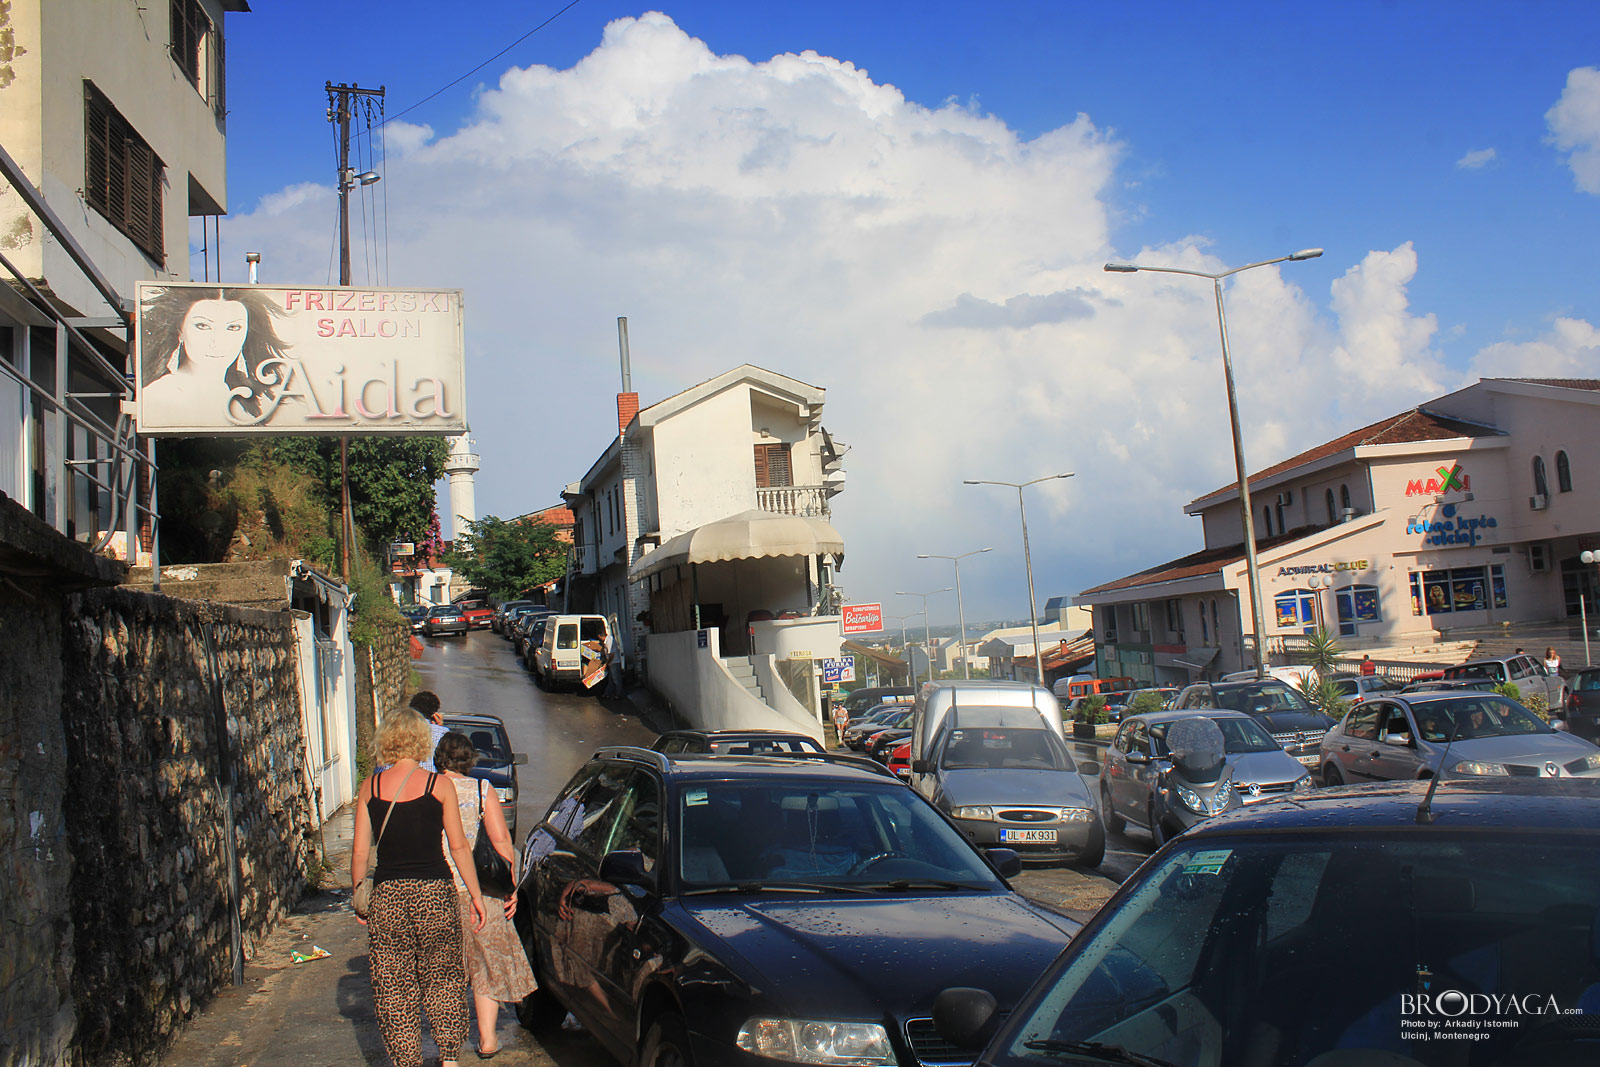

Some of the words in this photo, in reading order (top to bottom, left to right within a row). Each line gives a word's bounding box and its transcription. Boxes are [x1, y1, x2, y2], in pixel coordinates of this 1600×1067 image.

[285, 291, 450, 312] FRIZERSKI
[316, 317, 421, 338] SALON
[223, 356, 456, 425] Aida
[1405, 464, 1471, 497] MAXI
[1407, 519, 1454, 535] robna
[1277, 563, 1334, 577] ADMIRAL
[1334, 560, 1369, 572] CLUB
[1007, 830, 1020, 841] UL
[1026, 830, 1056, 841] AK931
